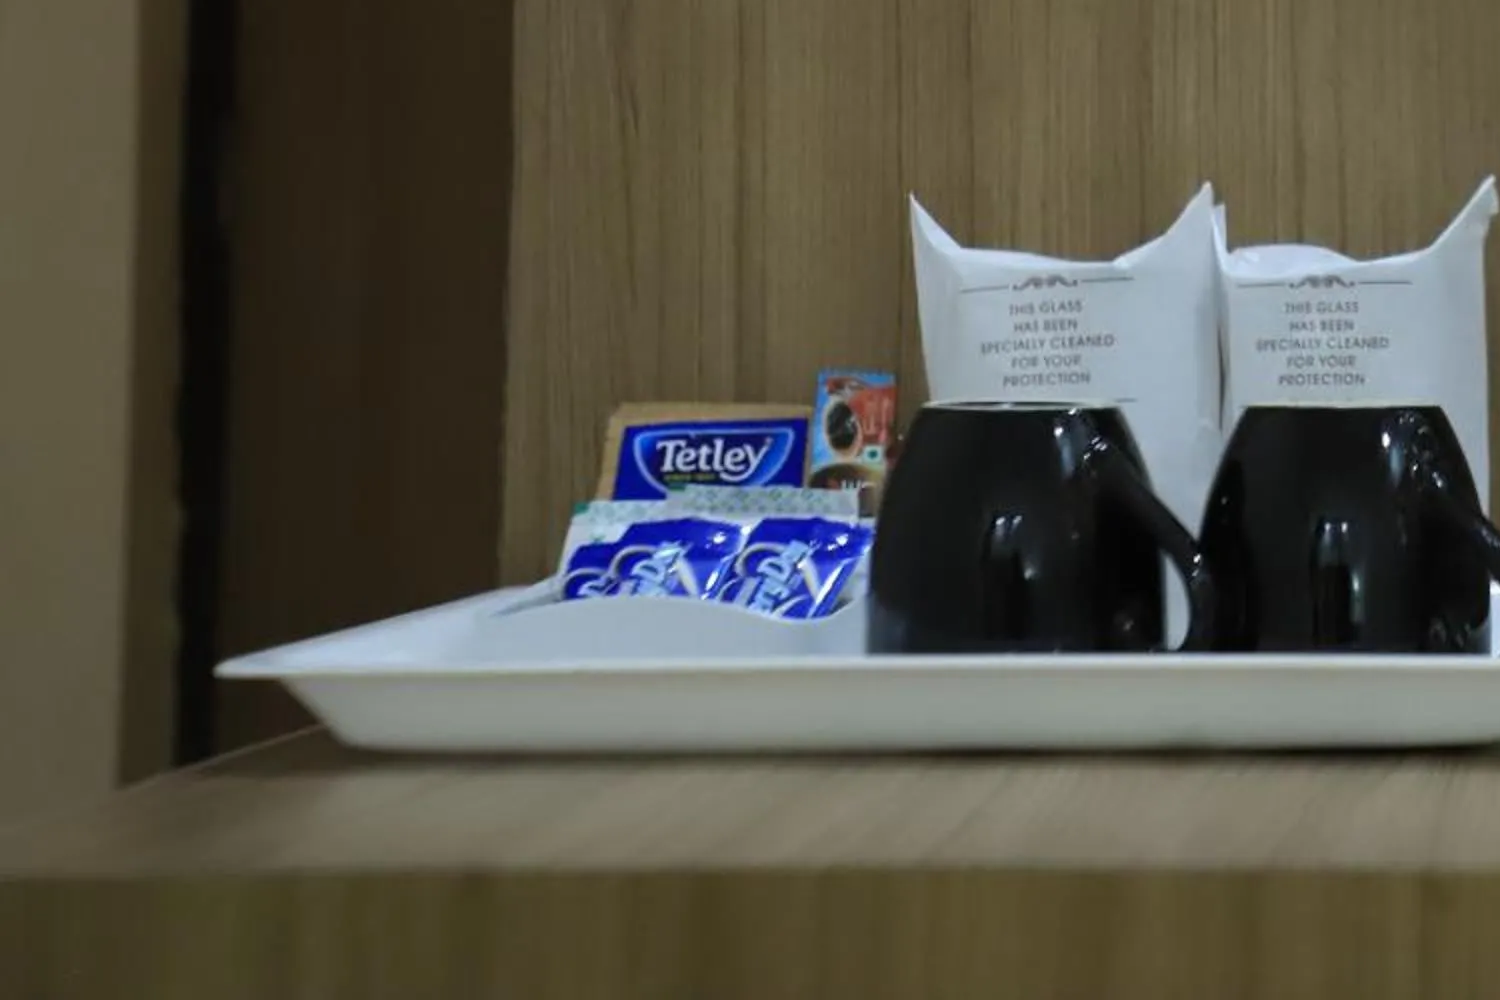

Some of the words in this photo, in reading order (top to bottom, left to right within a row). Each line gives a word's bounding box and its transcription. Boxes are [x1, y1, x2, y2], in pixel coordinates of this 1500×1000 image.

[1009, 303, 1034, 316] THIS
[1039, 299, 1082, 314] GLASS
[1285, 302, 1312, 314] THIS
[1316, 301, 1359, 314] GLASS
[1014, 321, 1038, 333] HAS
[1043, 319, 1078, 332] BEEN
[1289, 320, 1315, 331] HAS
[1320, 319, 1354, 331] BEEN
[1049, 334, 1115, 350] CLEANED
[1326, 336, 1390, 349] CLEANED
[1011, 356, 1038, 369] FOR
[1286, 355, 1315, 368] FOR
[1003, 371, 1091, 388] PROTECTION
[1279, 372, 1365, 386] PROTECTION
[655, 437, 773, 482] Tetley
